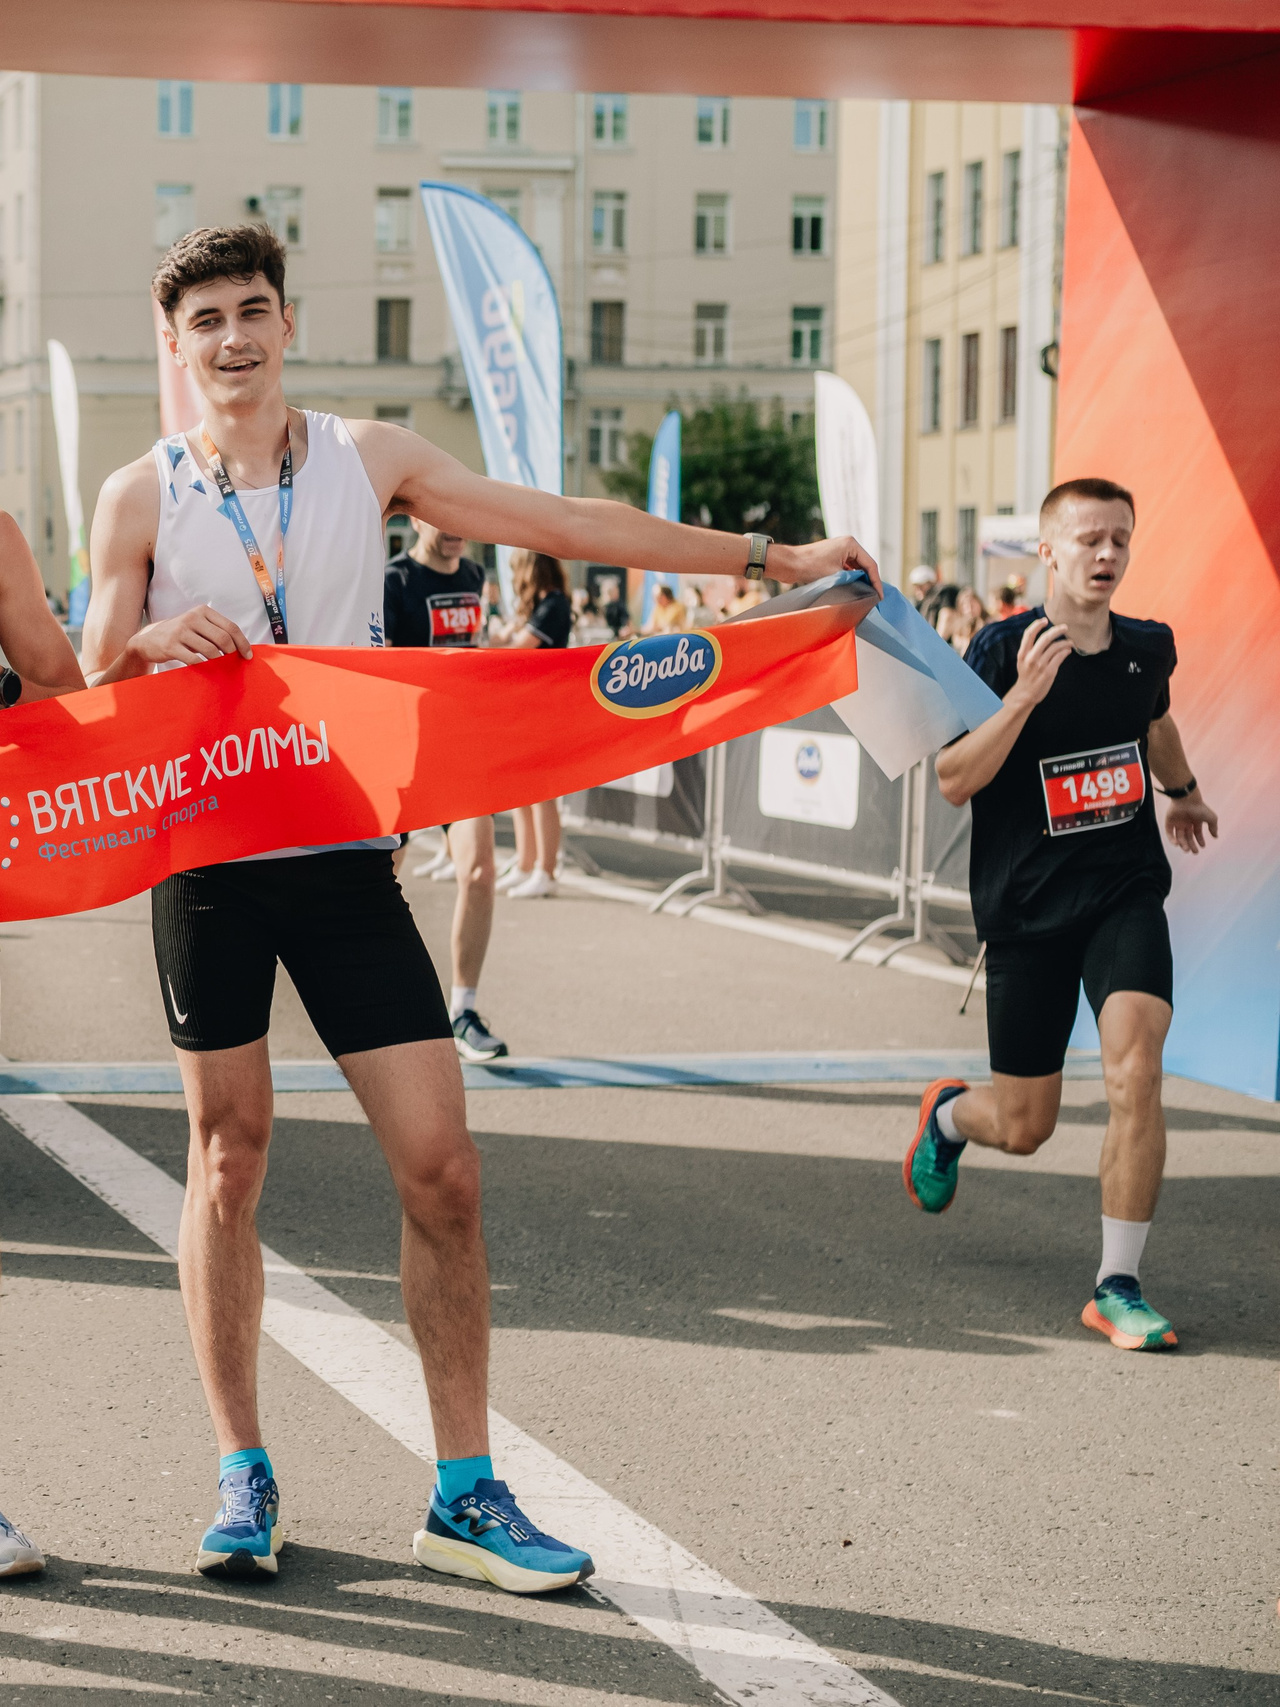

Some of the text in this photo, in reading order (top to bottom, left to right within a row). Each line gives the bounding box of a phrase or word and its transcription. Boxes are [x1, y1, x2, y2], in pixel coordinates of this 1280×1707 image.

[244, 538, 256, 557] 2025
[440, 608, 477, 629] 1281
[606, 637, 706, 694] Здрава
[27, 720, 330, 834] ВЯТСКИЕ ХОЛМЫ
[1062, 767, 1130, 803] 1498
[38, 795, 219, 862] Фестиваль спорта
